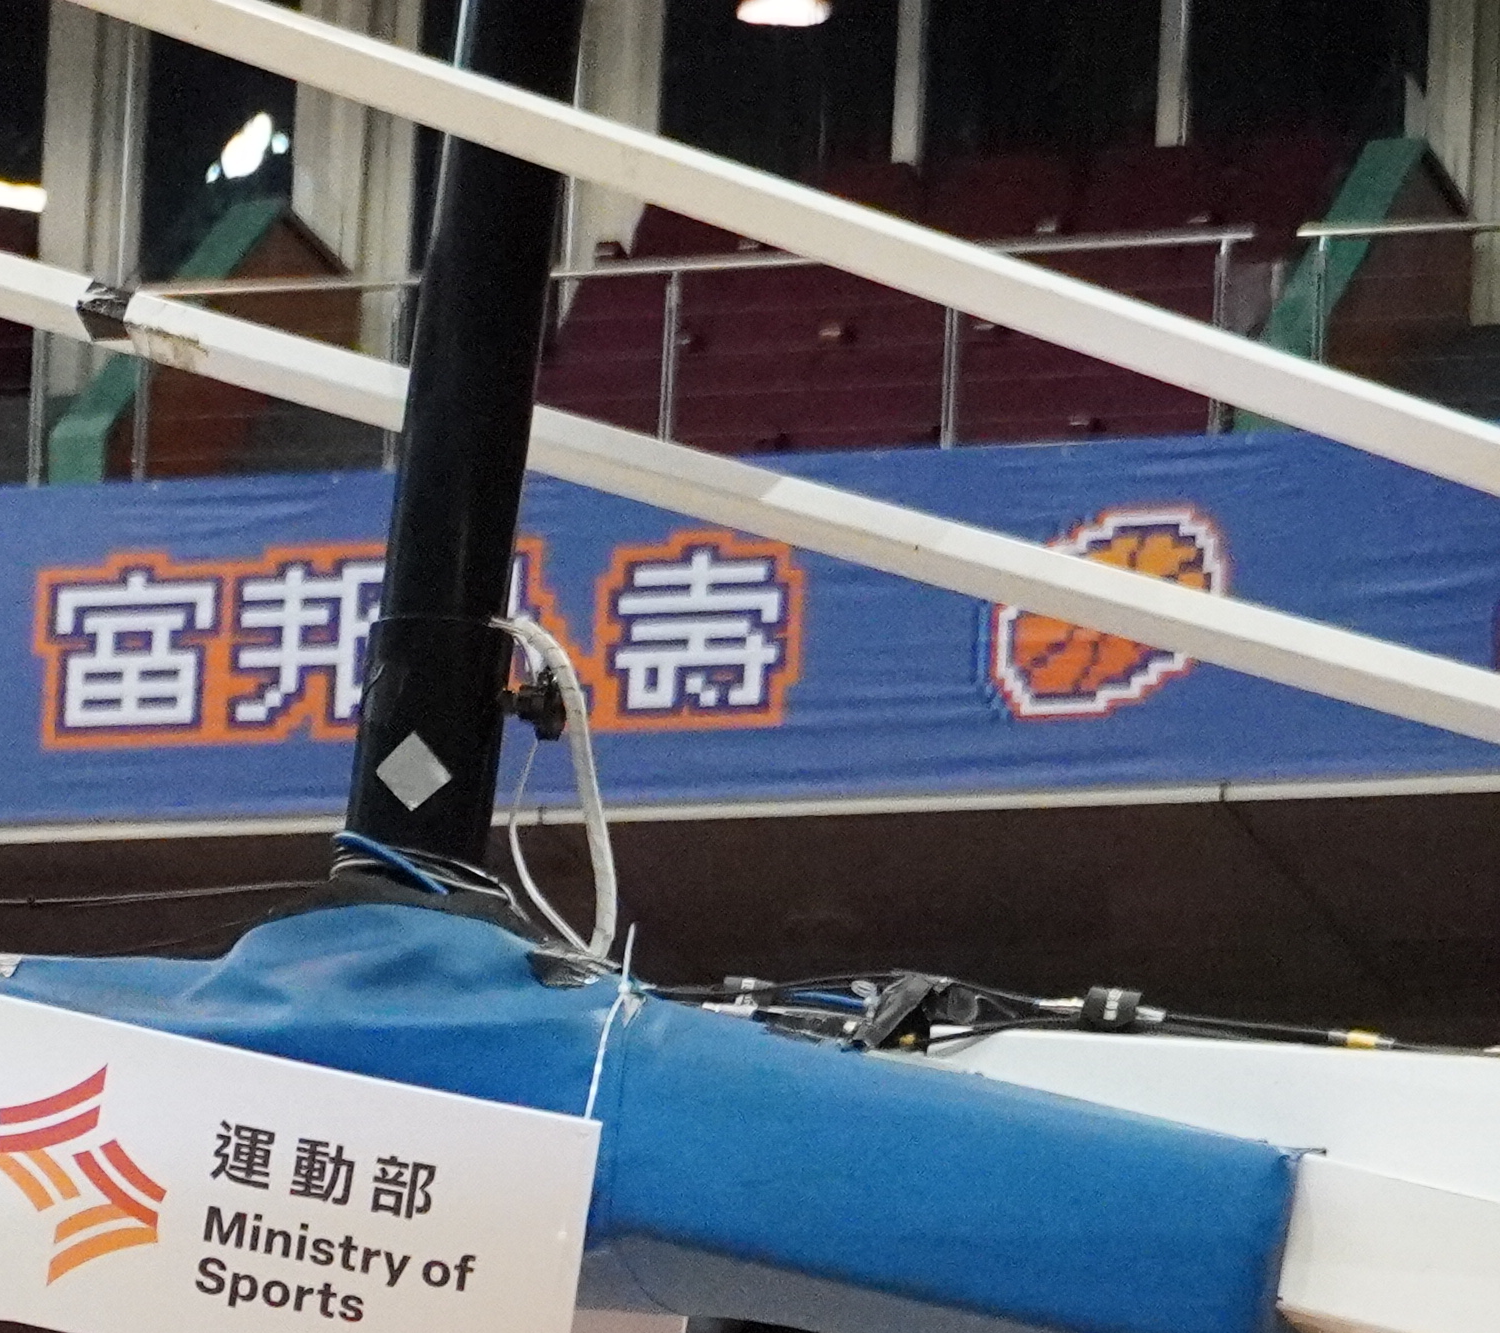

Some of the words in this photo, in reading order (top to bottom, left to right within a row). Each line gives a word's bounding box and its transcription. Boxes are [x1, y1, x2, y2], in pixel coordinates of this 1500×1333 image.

[54, 544, 788, 732] 富邦壽
[209, 1119, 437, 1220] 運動部
[195, 1257, 365, 1323] Sports
[203, 1205, 411, 1288] Ministry
[422, 1254, 477, 1292] of
